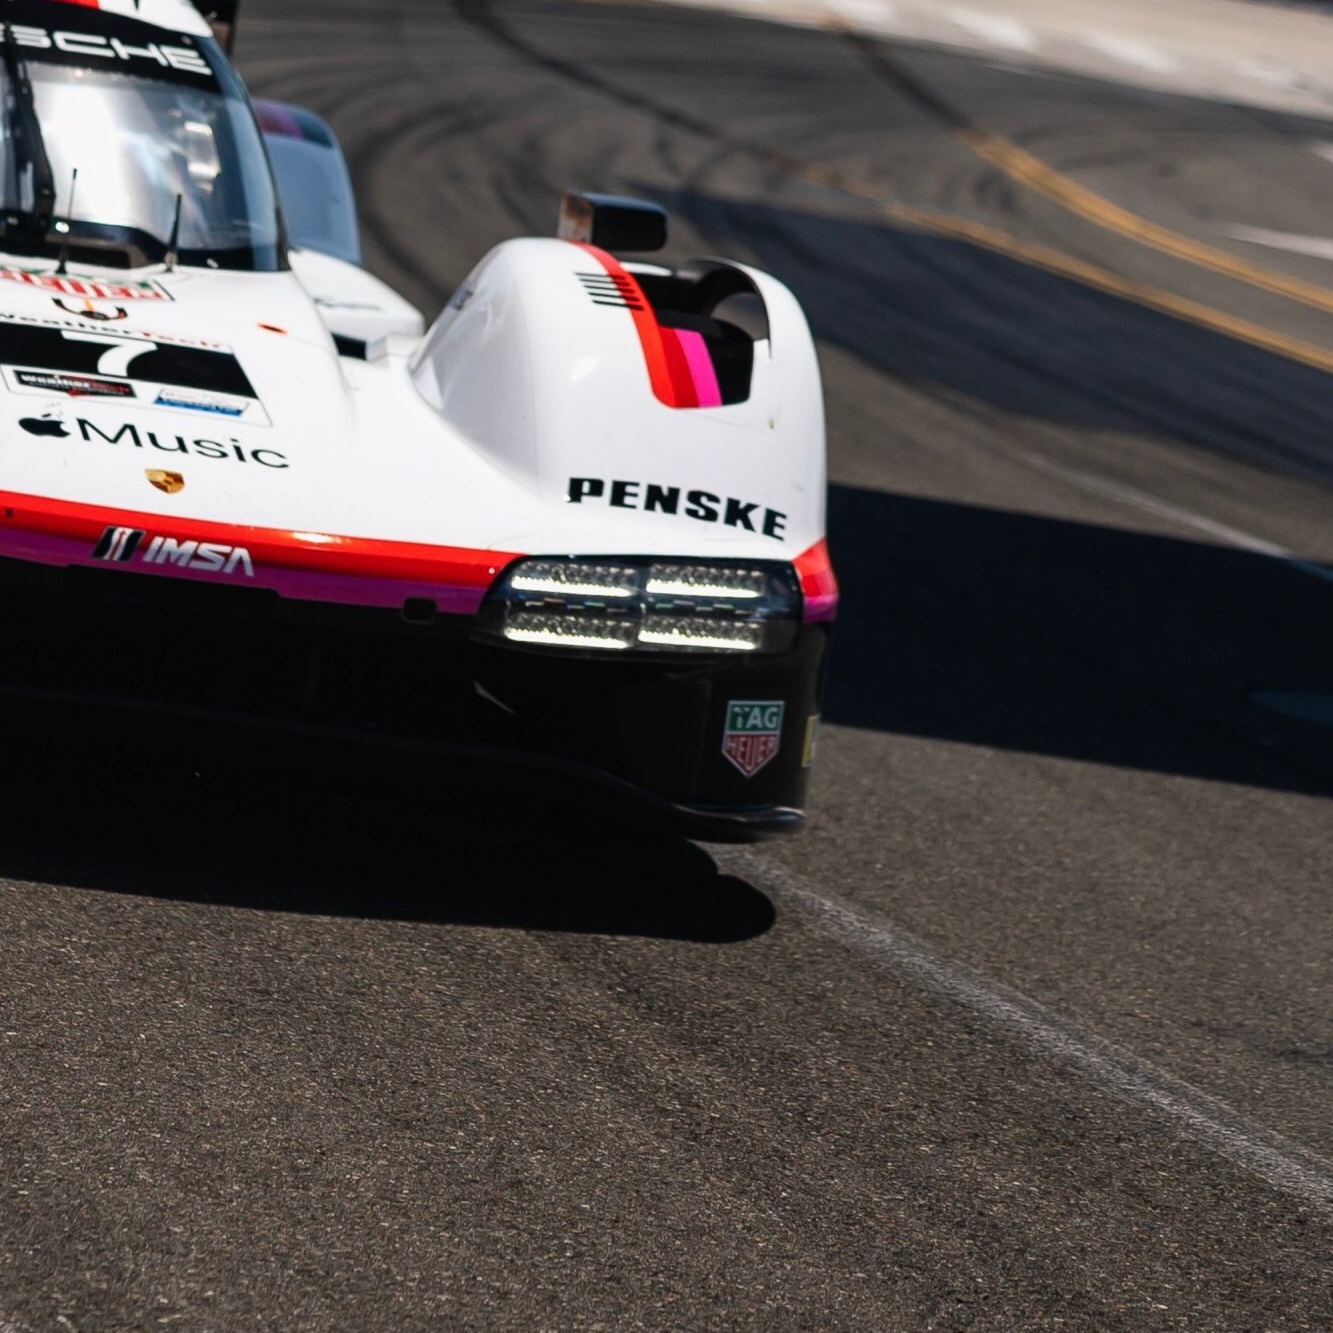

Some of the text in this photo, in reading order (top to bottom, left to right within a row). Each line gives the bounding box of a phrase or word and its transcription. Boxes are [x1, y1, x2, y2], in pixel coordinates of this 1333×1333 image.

[60, 328, 158, 377] 7
[75, 417, 291, 469] Music
[567, 477, 788, 542] PENSKE
[142, 536, 255, 578] IMSA
[732, 706, 779, 730] TAG
[727, 735, 778, 775] HEUER
